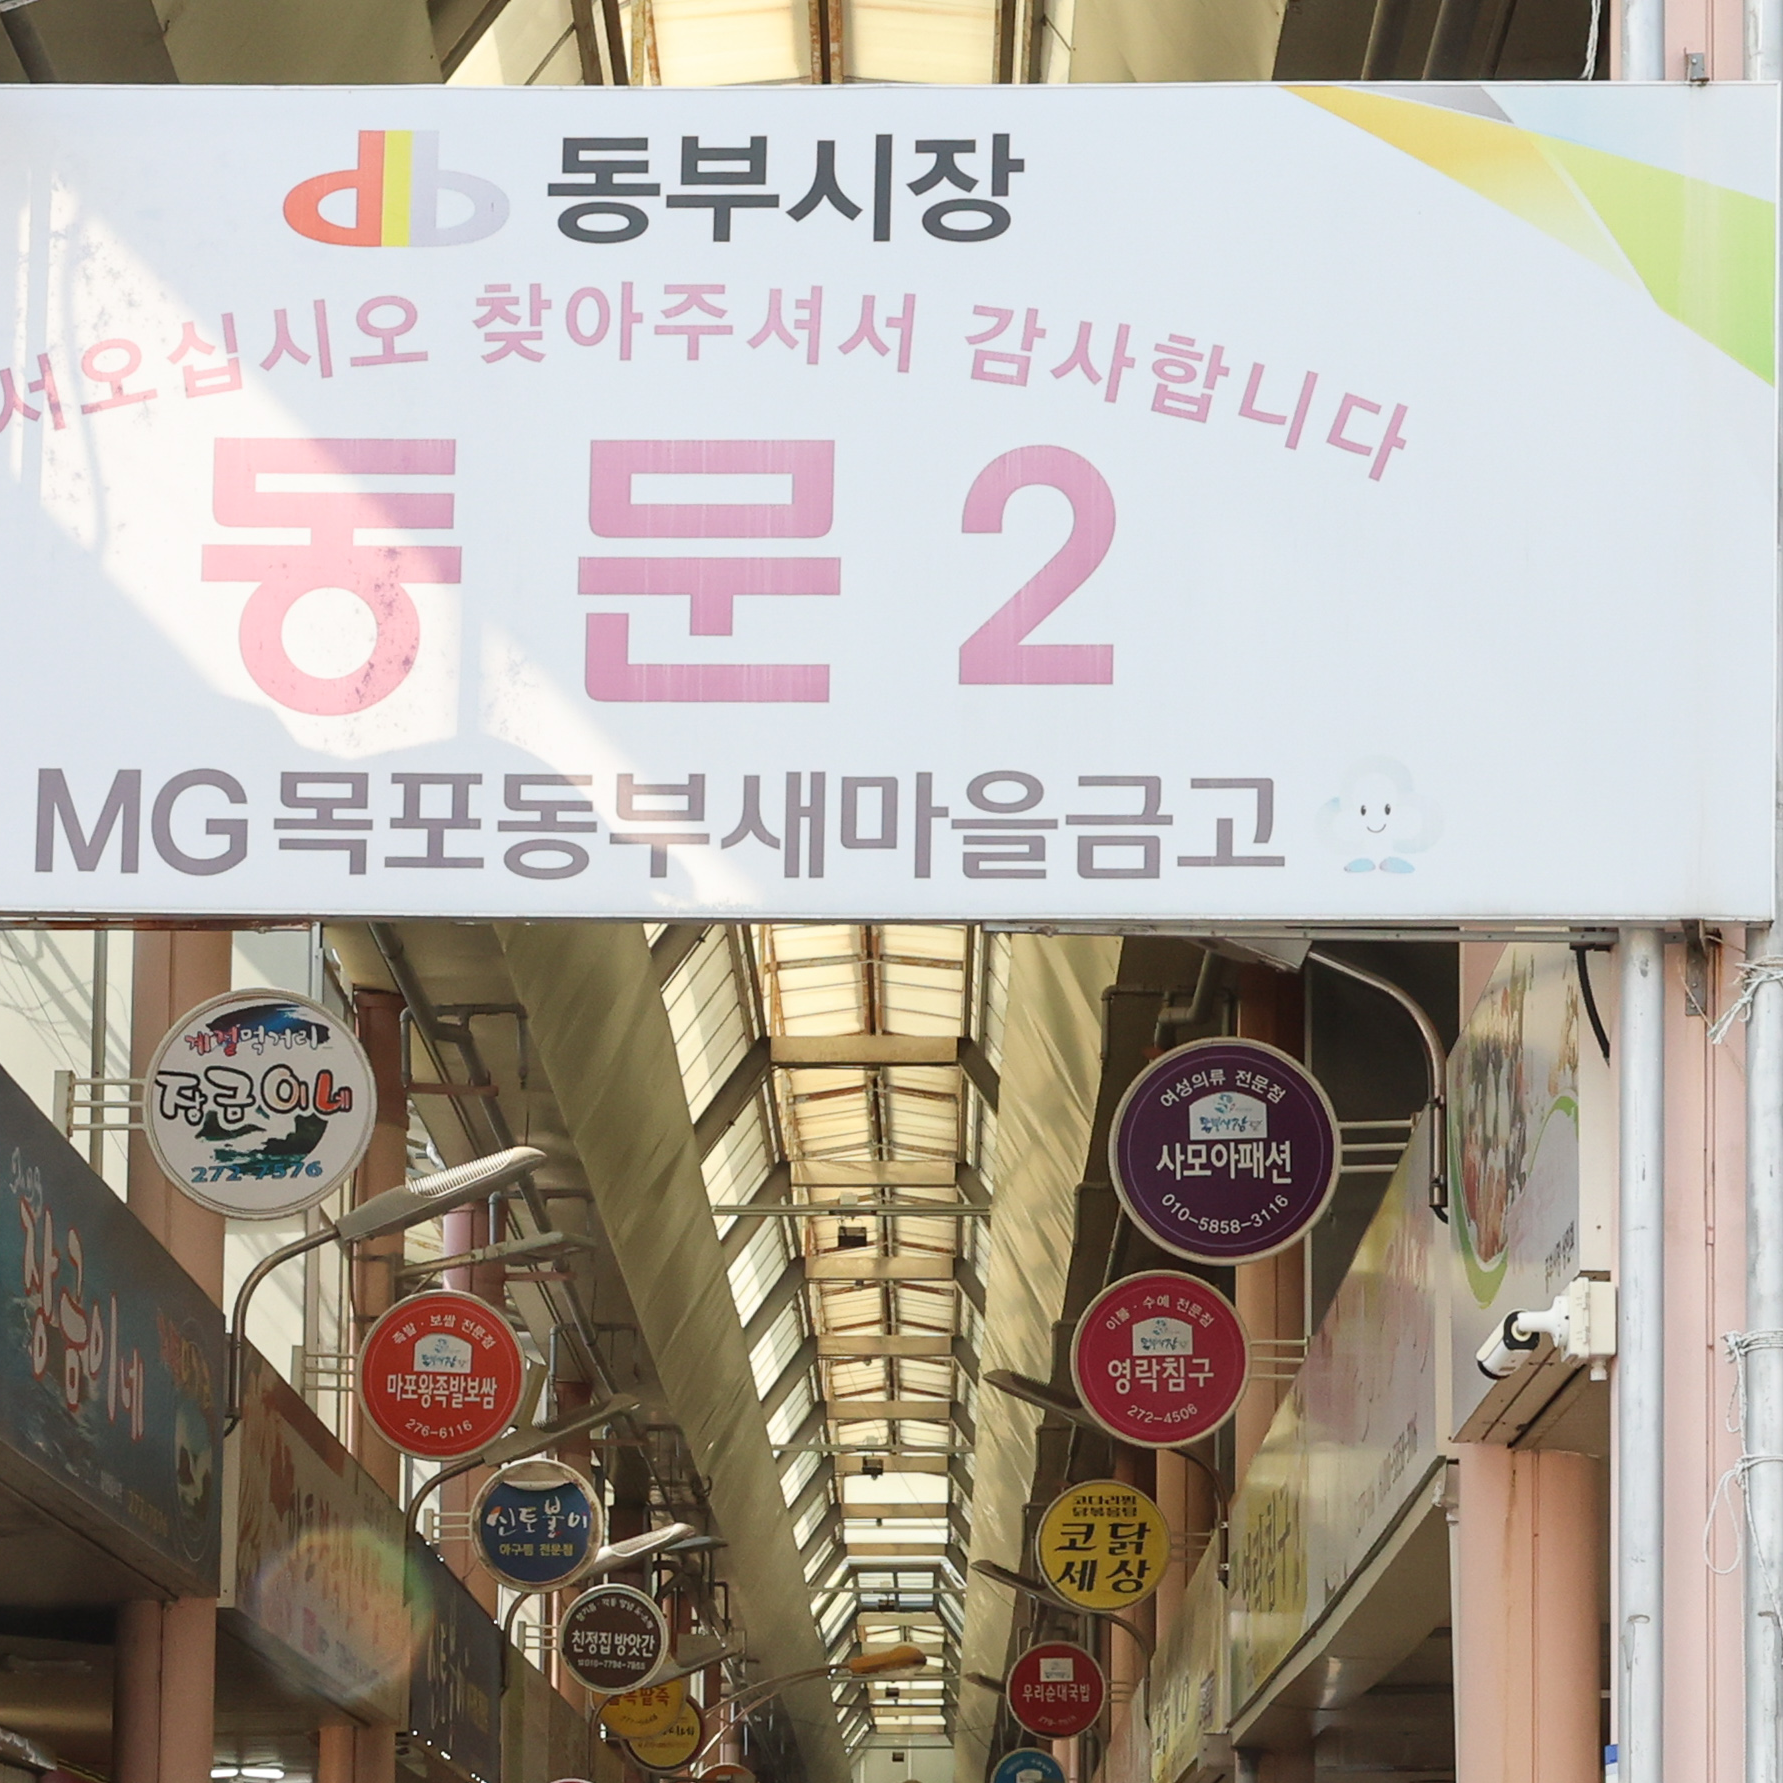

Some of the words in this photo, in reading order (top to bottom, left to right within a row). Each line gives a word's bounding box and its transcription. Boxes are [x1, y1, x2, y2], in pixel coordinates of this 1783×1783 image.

[545, 130, 1027, 247] 동부시장
[470, 281, 918, 377] 찾아주셔서
[961, 301, 1413, 482] 감사합니다
[956, 442, 1116, 687] 2
[1160, 1069, 1226, 1107] 여성의류
[1235, 1069, 1288, 1104] 전문점
[1156, 1140, 1293, 1184] 사모아패션
[1161, 1193, 1289, 1235] 010-5858-3116
[1106, 1309, 1130, 1331] 이불
[1142, 1295, 1170, 1310] 수예
[1176, 1297, 1215, 1328] 전문점
[461, 1318, 497, 1350] 전문점
[387, 1374, 498, 1410] 마포왕족발보쌈
[1108, 1357, 1215, 1395] 영락침구
[405, 1418, 473, 1439] 276-6116
[1127, 1403, 1198, 1423] 272-4506
[486, 1496, 588, 1538] 신토불이
[1055, 1559, 1151, 1593] 세상
[571, 1629, 612, 1655] 친정집
[614, 1633, 655, 1658] 방앗간
[1023, 1683, 1091, 1702] 우리순대국밥
